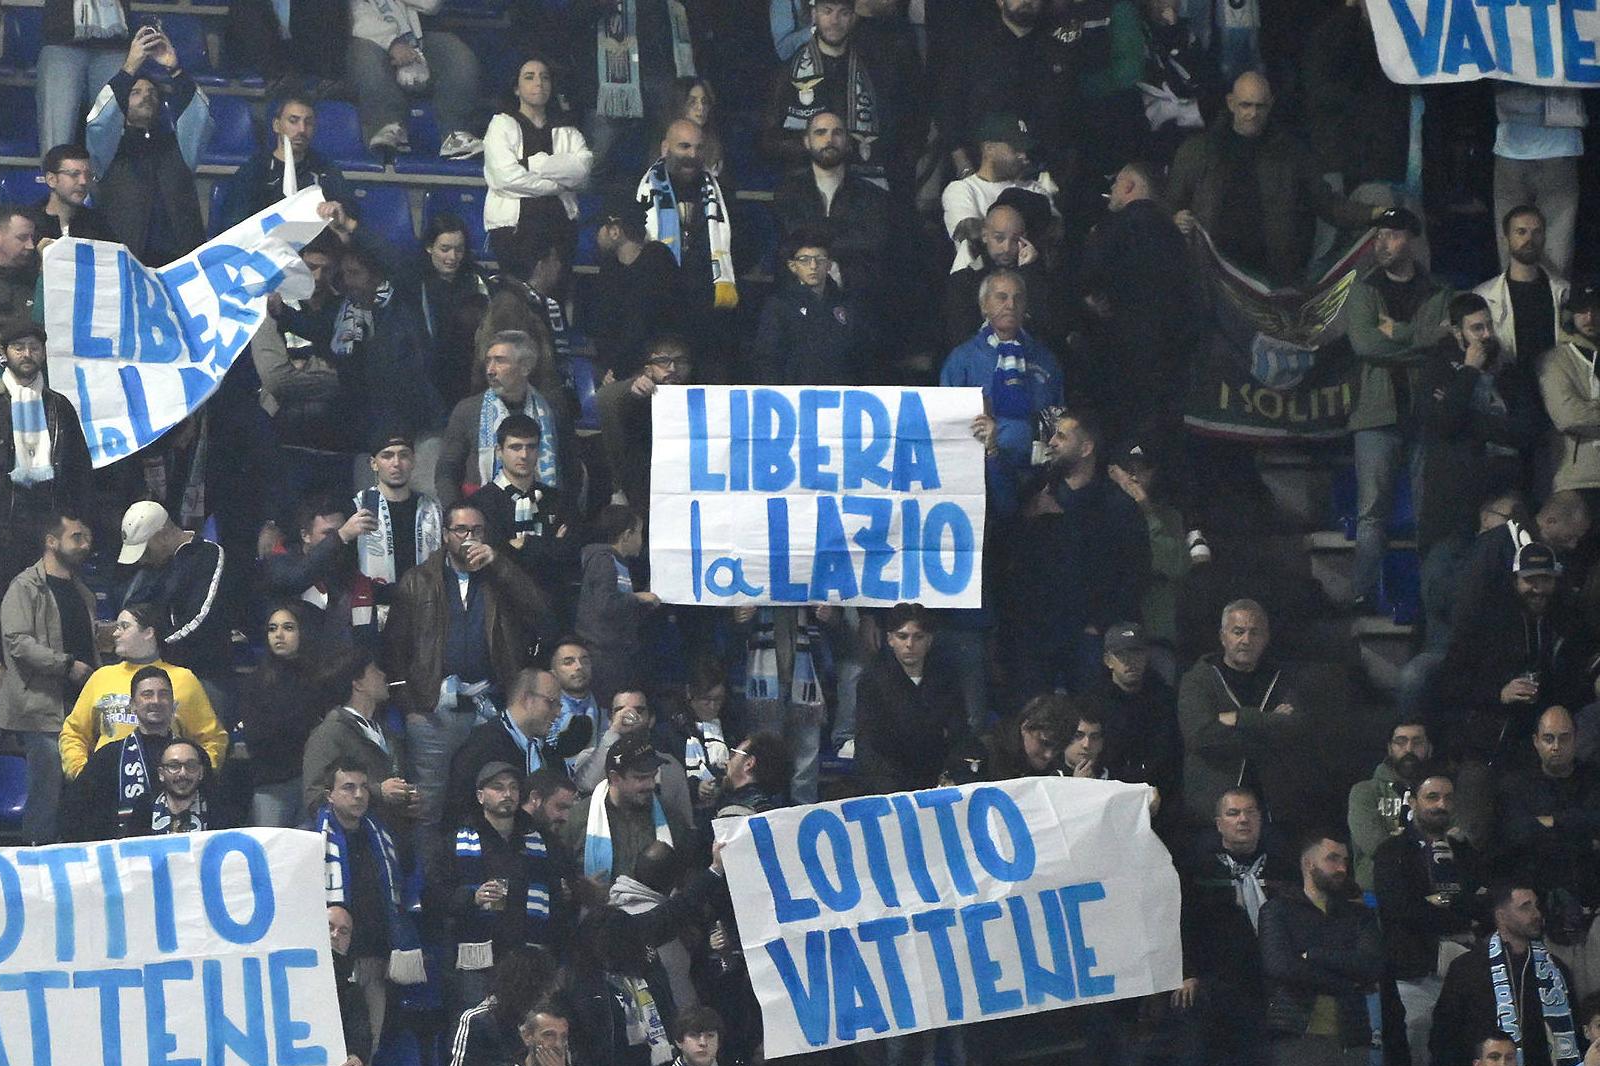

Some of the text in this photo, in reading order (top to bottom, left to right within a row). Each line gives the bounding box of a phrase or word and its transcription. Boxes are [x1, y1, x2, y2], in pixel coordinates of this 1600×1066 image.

[1389, 0, 1600, 82] VATTE
[75, 367, 130, 461] la
[687, 389, 941, 492] LIBERA
[691, 495, 974, 602] la LAZIO
[748, 787, 1036, 923] LOTITO
[765, 882, 1115, 1046] VATTENE
